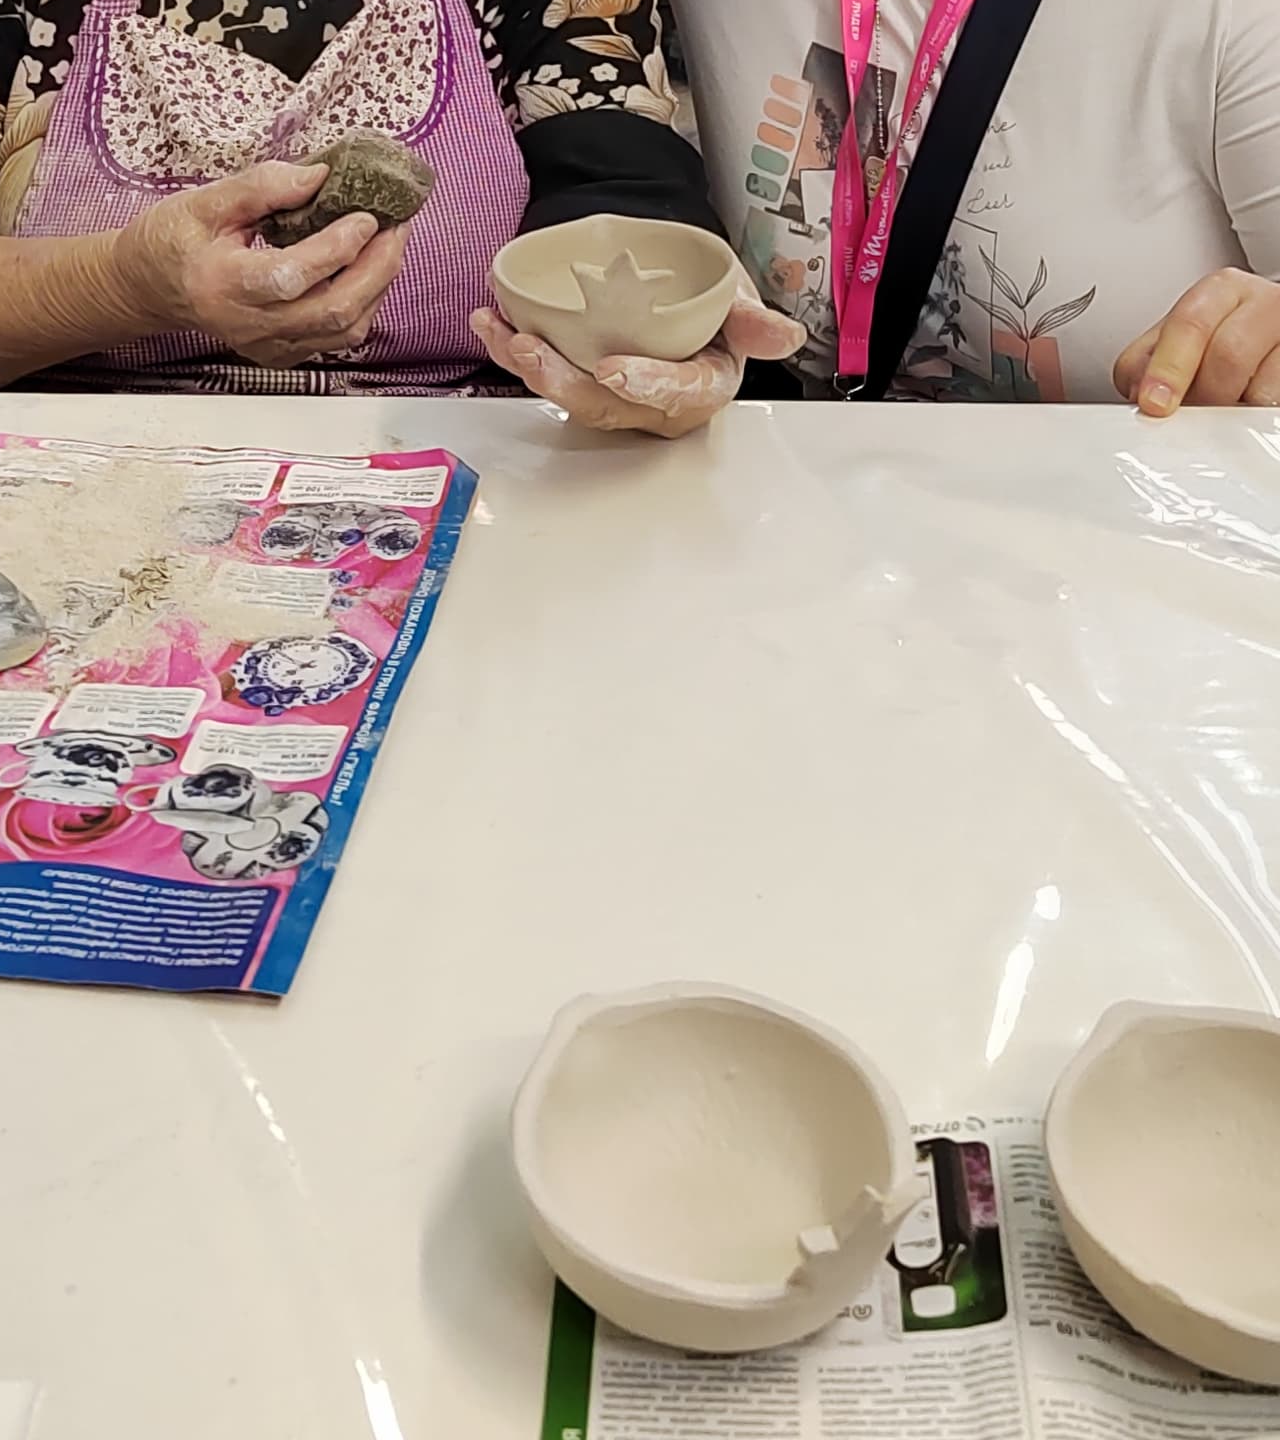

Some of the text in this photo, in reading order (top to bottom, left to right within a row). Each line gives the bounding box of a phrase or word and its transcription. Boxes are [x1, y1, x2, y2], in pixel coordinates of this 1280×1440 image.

[415, 569, 438, 597] ДОБРО
[390, 599, 426, 660] ПОЖАЛОВАТЬ
[371, 667, 396, 700] СТРАНУ
[350, 702, 381, 750] ФАРФОРА
